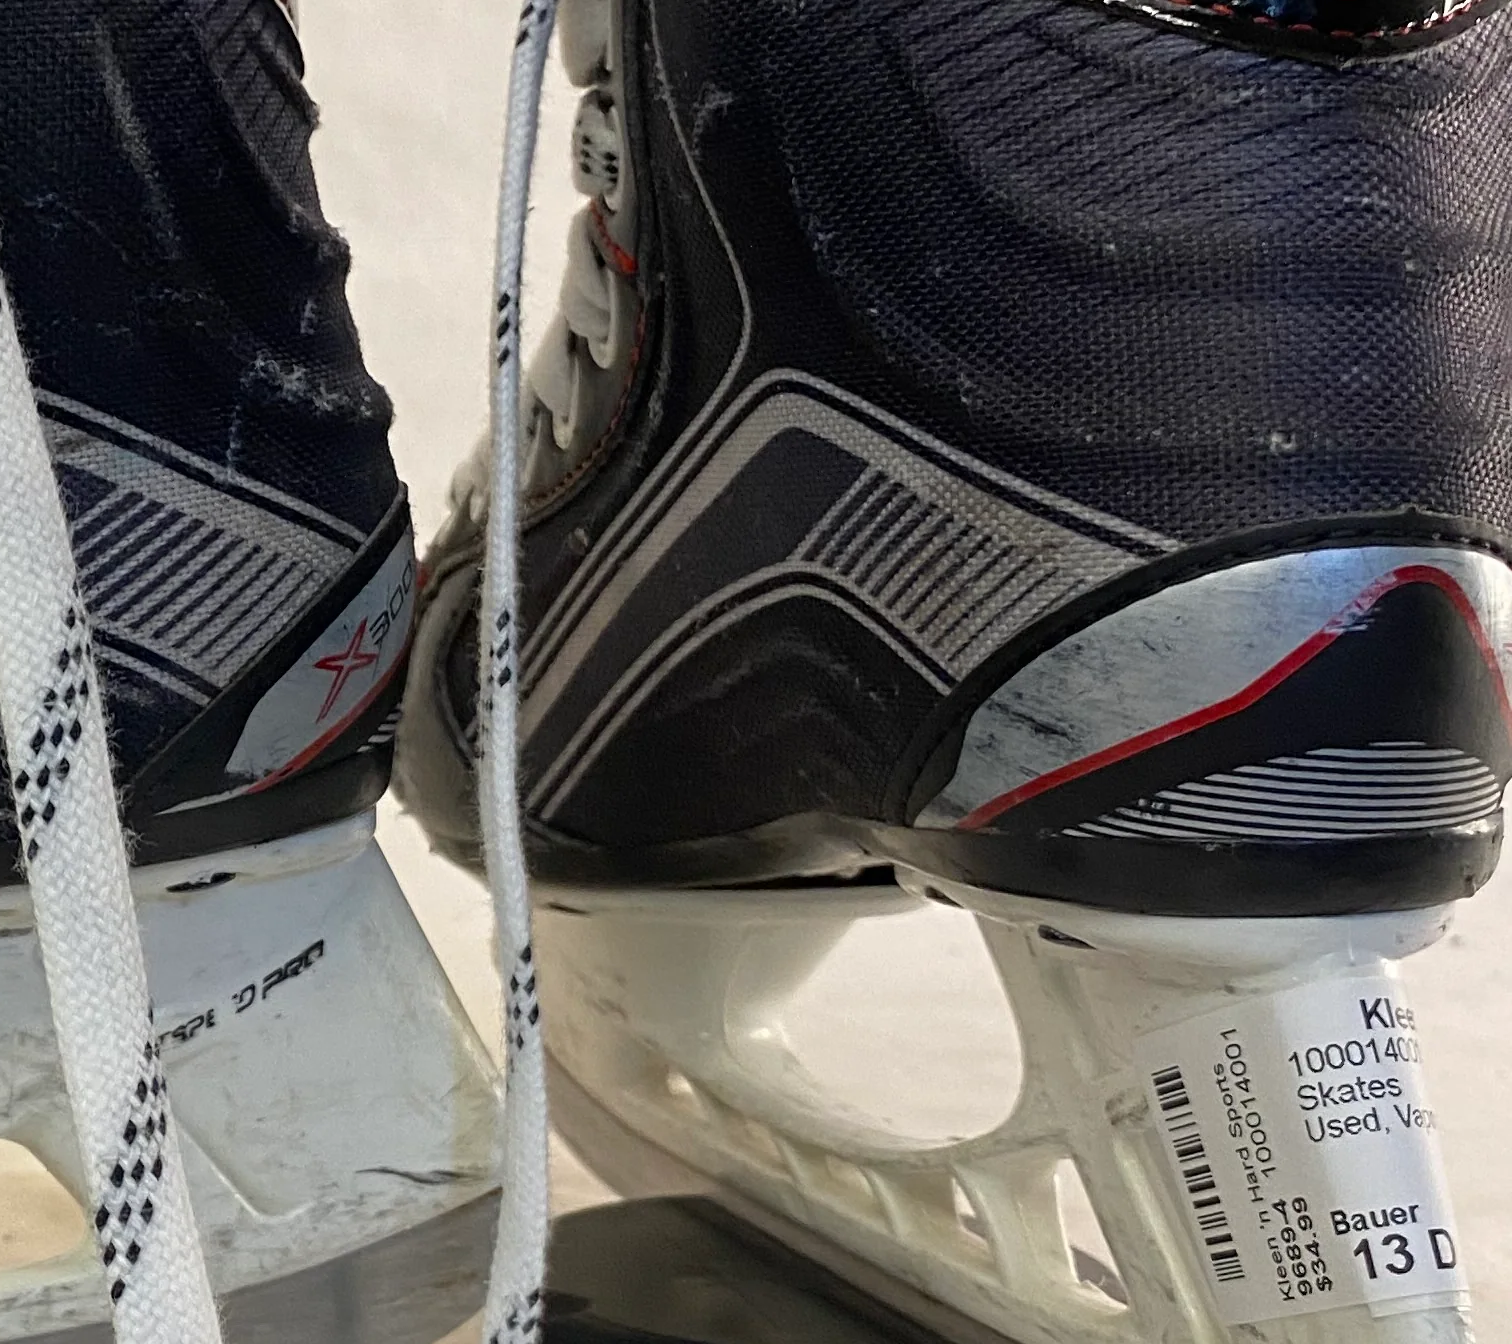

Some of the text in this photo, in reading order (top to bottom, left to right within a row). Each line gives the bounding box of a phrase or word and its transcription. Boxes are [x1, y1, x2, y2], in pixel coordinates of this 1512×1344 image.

[1359, 998, 1415, 1029] Klee
[1213, 1063, 1243, 1139] Sports
[1221, 1028, 1277, 1179] 100014001
[1297, 1074, 1403, 1112] Skates
[1304, 1106, 1391, 1143] Used,
[1238, 1147, 1265, 1203] Hard
[1291, 1196, 1333, 1291] $34.99
[1330, 1202, 1420, 1236] Bauer
[1266, 1237, 1294, 1301] Kleen
[1353, 1228, 1457, 1280] 13 D
